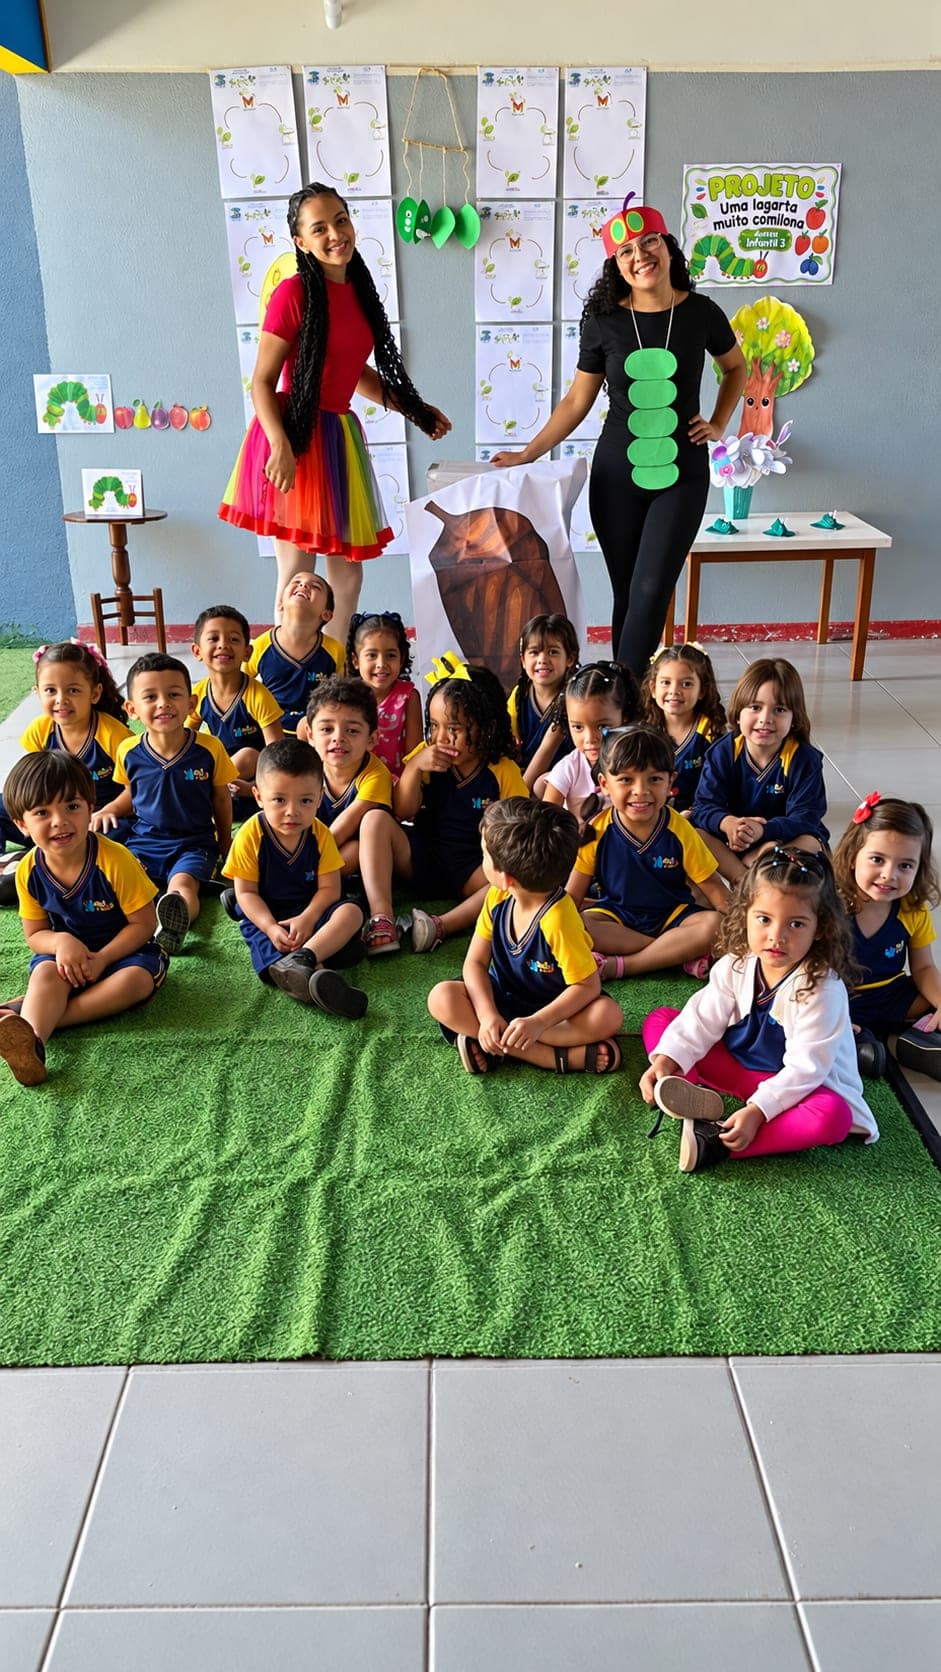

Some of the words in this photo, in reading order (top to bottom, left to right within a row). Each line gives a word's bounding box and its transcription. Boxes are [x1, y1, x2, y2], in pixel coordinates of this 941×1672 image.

[708, 173, 815, 201] PROJETO
[720, 202, 748, 215] Uma
[753, 199, 798, 214] lagarta
[713, 215, 749, 231] muito
[753, 214, 804, 229] comilona
[746, 238, 778, 247] Infantil
[780, 238, 786, 248] 3
